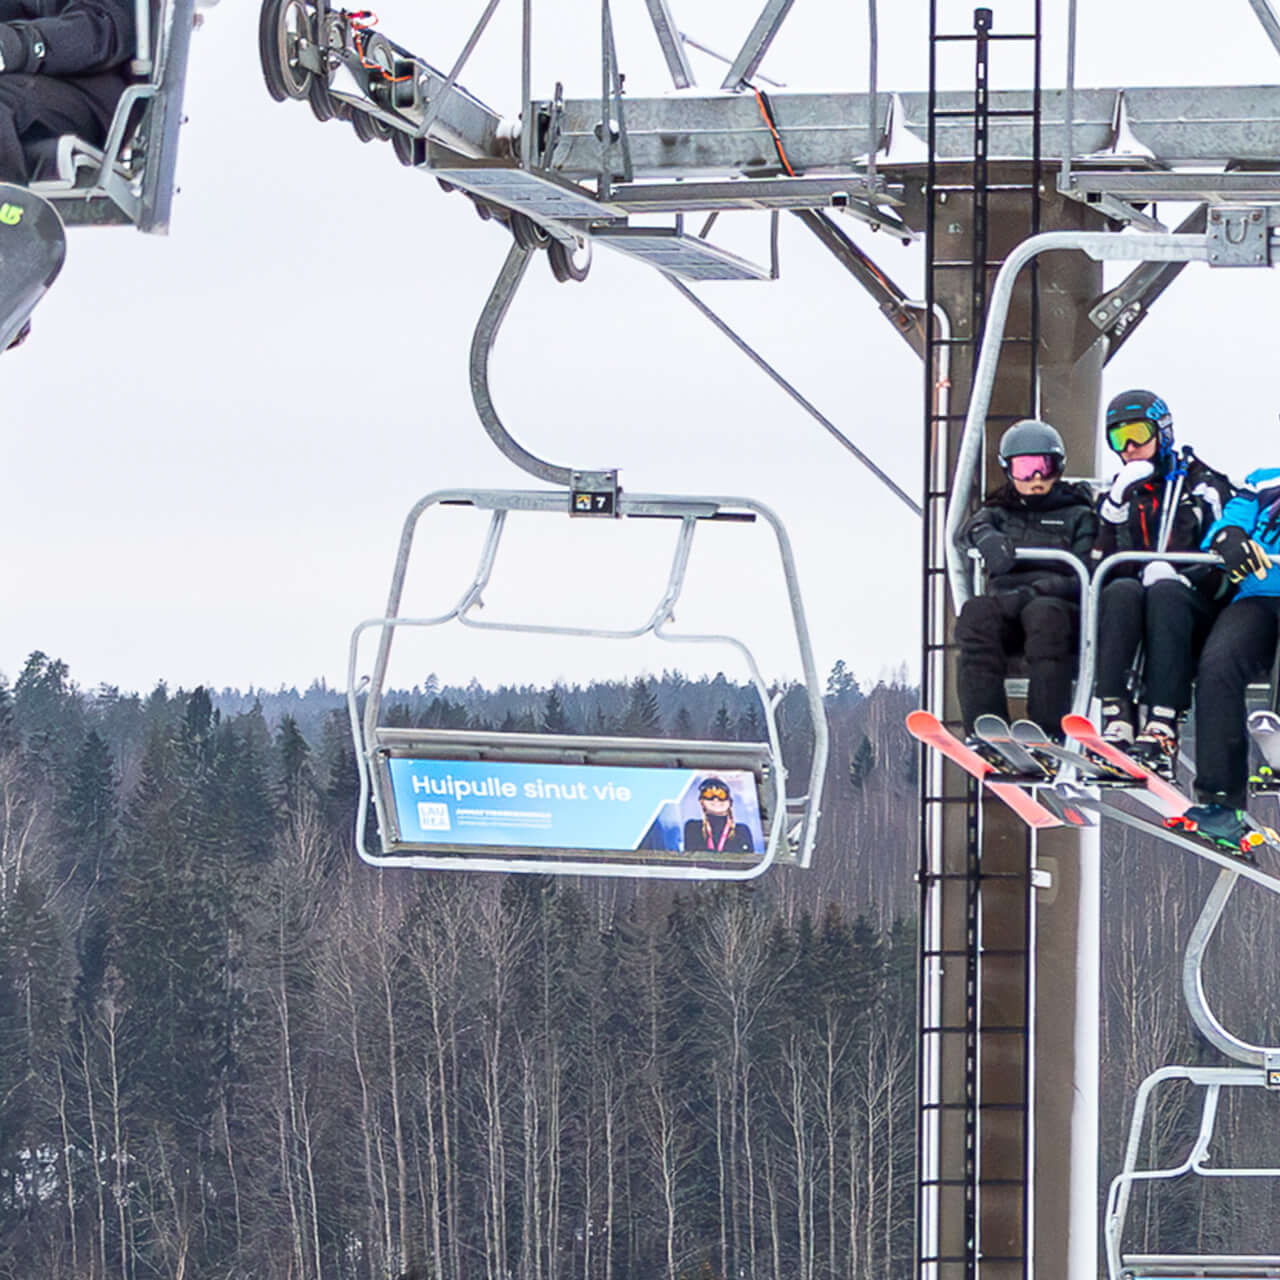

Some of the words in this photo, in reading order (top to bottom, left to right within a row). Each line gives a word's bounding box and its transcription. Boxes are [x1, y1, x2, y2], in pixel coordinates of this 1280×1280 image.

[596, 496, 606, 509] 7
[411, 775, 518, 801] Huipulle
[524, 778, 588, 801] sinut
[592, 780, 632, 802] vie
